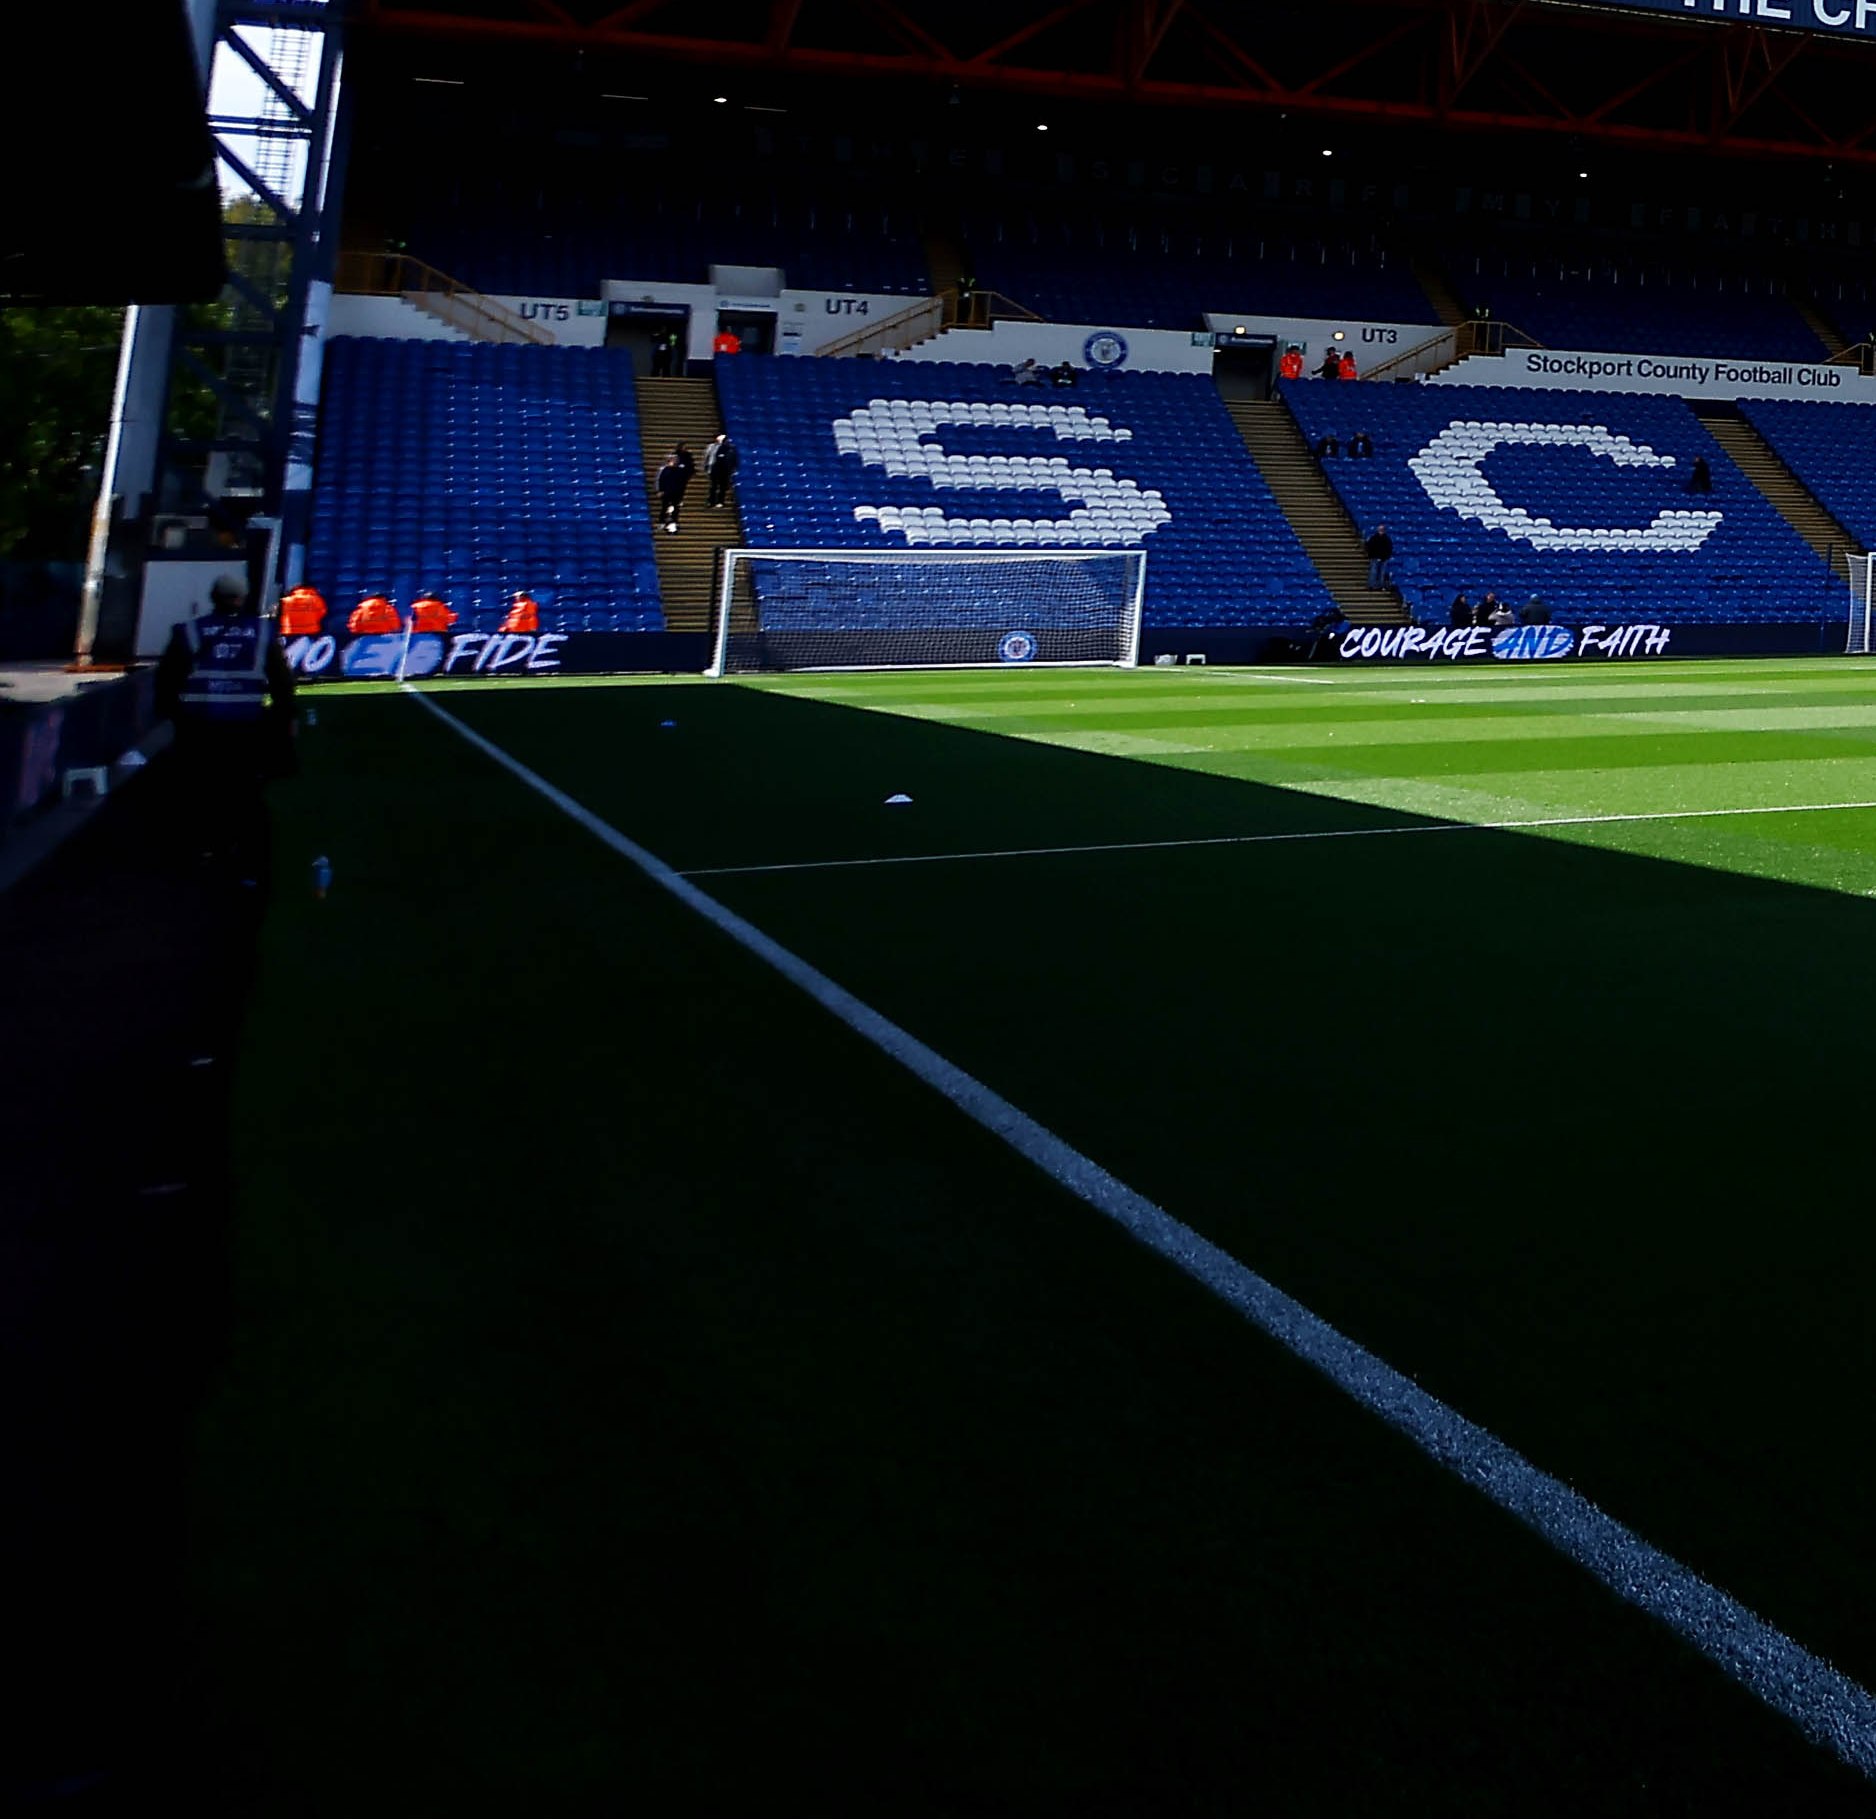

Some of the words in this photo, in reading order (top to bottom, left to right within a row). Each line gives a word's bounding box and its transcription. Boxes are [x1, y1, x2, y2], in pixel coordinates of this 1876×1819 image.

[520, 302, 569, 321] UT5
[825, 298, 870, 315] UT4
[1362, 328, 1398, 344] UT3
[1527, 353, 1632, 379] Stockport
[1637, 359, 1710, 385] County
[1714, 363, 1793, 385] Football
[1797, 367, 1842, 387] Club
[829, 398, 1172, 547] S
[1408, 420, 1725, 552] C
[445, 633, 568, 672] FIDE
[1340, 625, 1493, 660] COURAGE
[1493, 625, 1575, 660] AND
[1577, 625, 1671, 657] FAITH
